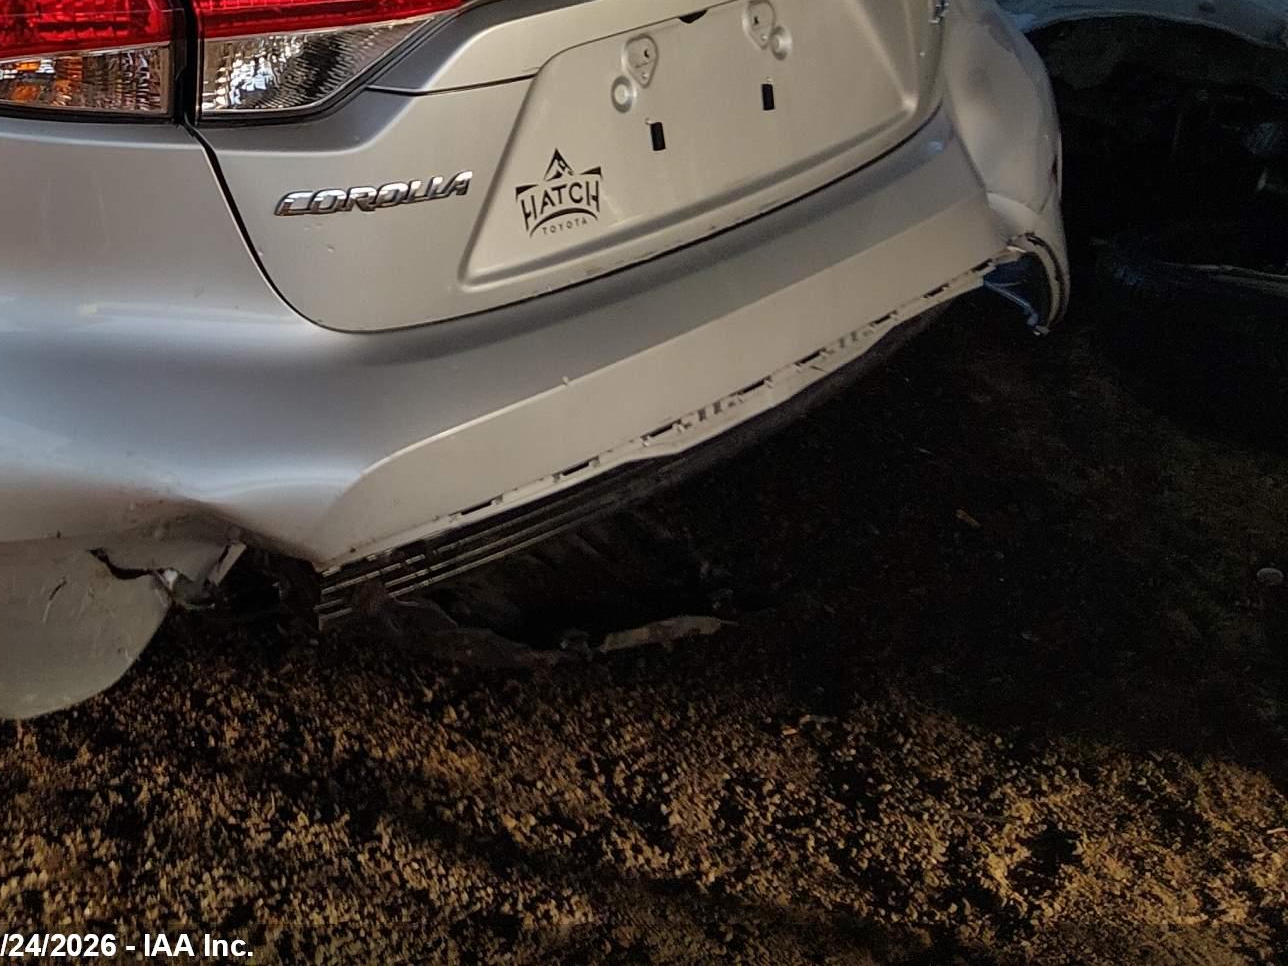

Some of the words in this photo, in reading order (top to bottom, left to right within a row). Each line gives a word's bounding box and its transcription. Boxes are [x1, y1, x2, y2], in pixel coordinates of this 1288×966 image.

[274, 170, 473, 216] COROLLA
[520, 180, 600, 232] HATCH
[542, 217, 588, 235] TOYOTA
